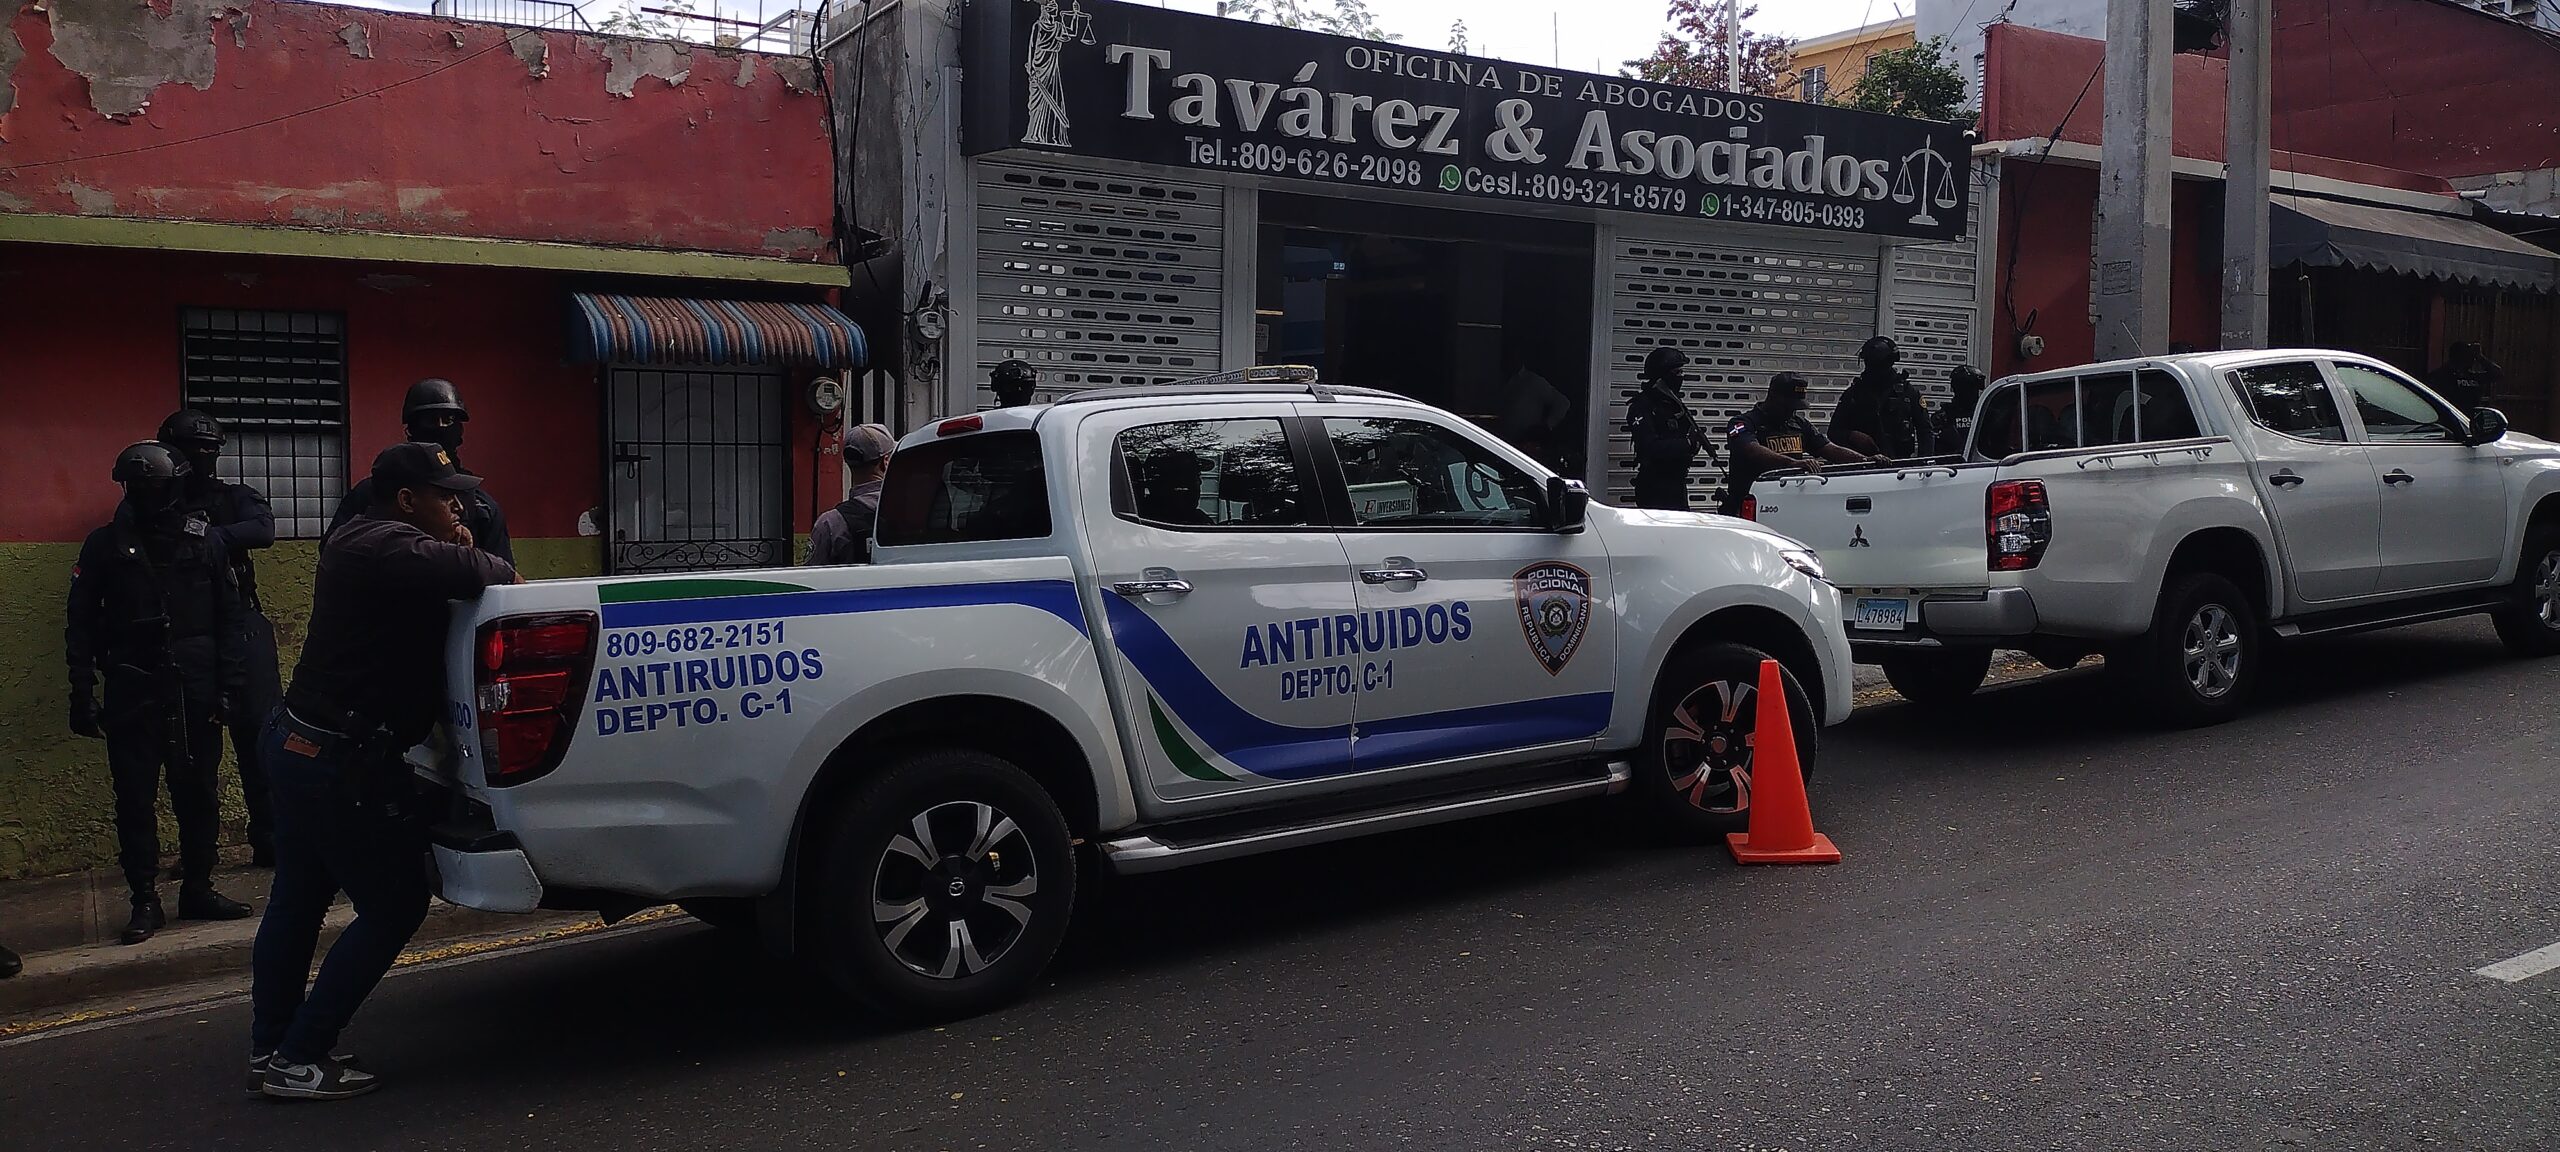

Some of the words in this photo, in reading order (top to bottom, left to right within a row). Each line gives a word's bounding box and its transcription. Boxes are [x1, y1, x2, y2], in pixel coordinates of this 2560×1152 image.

[1345, 45, 1503, 90] OFICINA
[1518, 70, 1563, 98] DE
[1576, 80, 1765, 123] ABOGADOS
[1106, 43, 1460, 156] Tavárez
[1485, 98, 1547, 164] &
[1565, 109, 1889, 202] Asociados
[1185, 135, 1422, 185] Tel.:809-626-2098
[1722, 196, 1865, 229] 1-347-805-0393
[1520, 579, 1588, 599] NACIONAL
[1528, 568, 1579, 583] POLICIA
[607, 621, 785, 657] 809-682-2151
[1240, 600, 1472, 669] ANTIRUIDOS
[1521, 606, 1551, 663] REPUBLICA
[1559, 602, 1588, 661] DOMINICANA
[1857, 606, 1903, 624] L478984
[594, 648, 824, 703] ANTIRUIDOS
[1281, 664, 1358, 701] DEPTO.
[1363, 659, 1394, 692] C-1
[596, 697, 728, 737] DEPTO.
[739, 687, 794, 720] C-1
